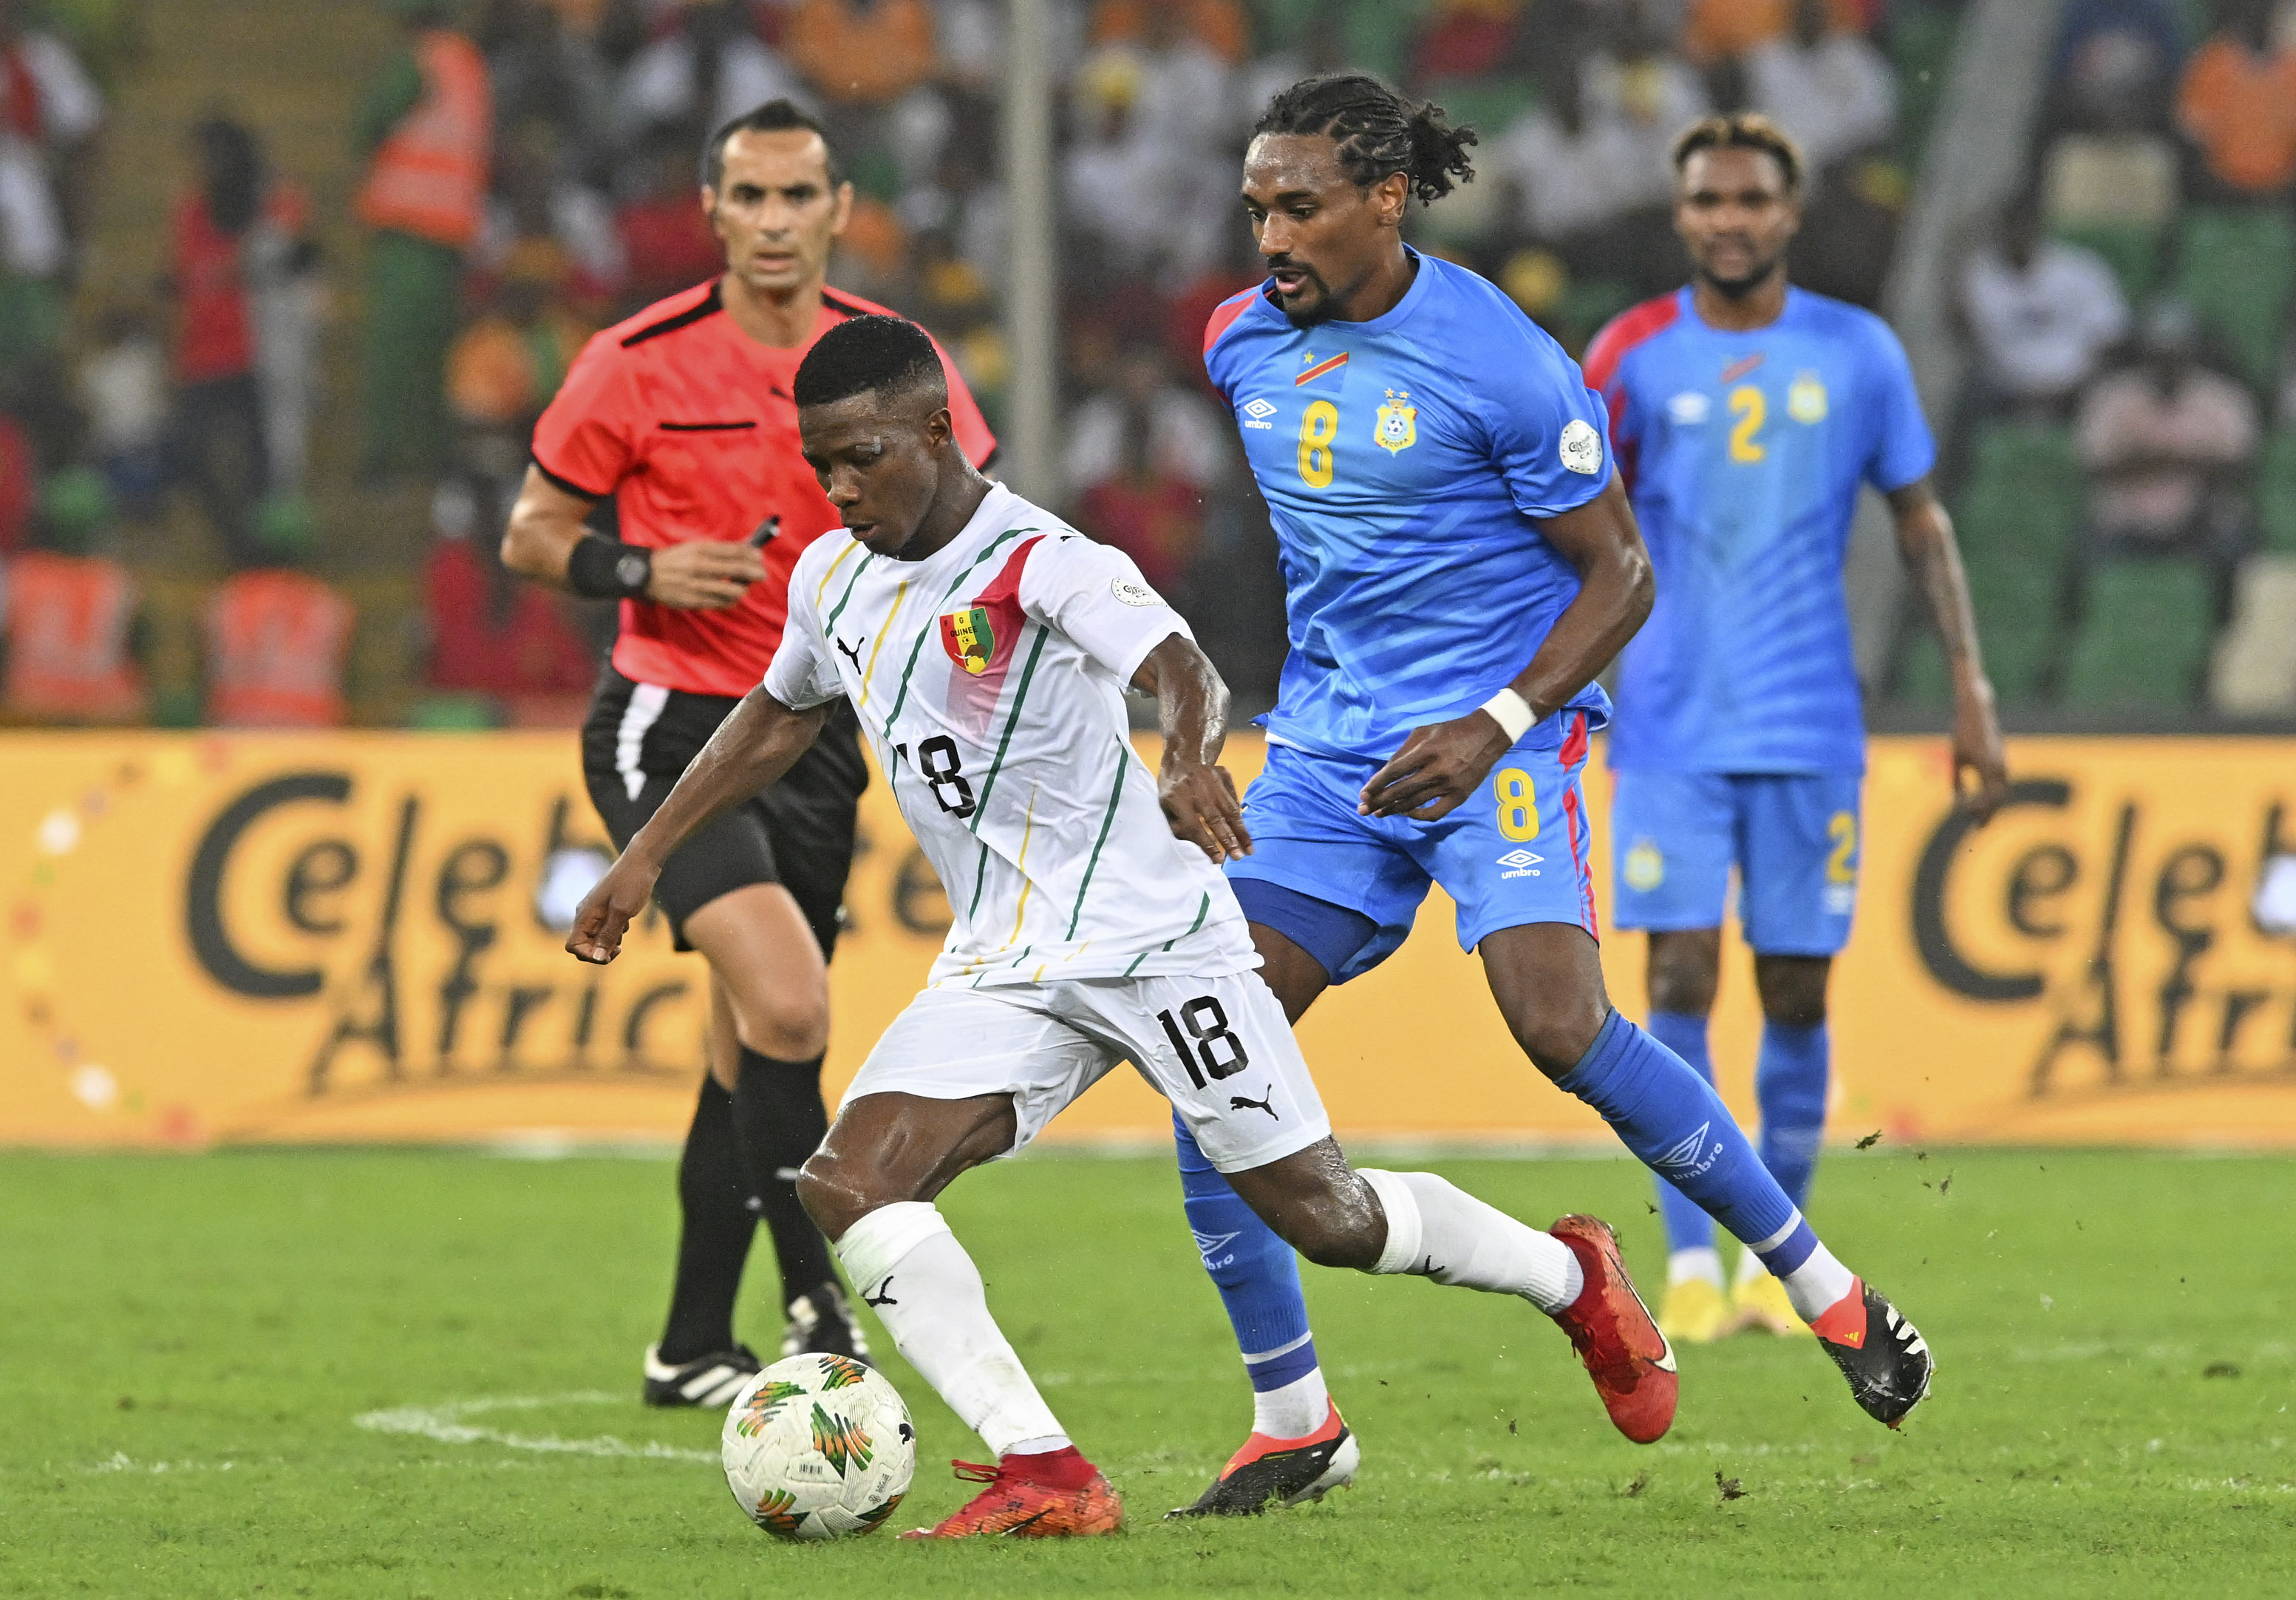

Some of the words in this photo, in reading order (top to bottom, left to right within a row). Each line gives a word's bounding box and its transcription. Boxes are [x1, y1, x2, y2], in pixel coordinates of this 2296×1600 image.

[1244, 419, 1272, 430] umbro
[1298, 400, 1338, 488] 8
[1730, 385, 1765, 463] 2
[950, 625, 978, 638] GUINEE
[896, 735, 977, 820] 8
[1493, 767, 1540, 842] 8
[1501, 868, 1541, 879] umbro
[1825, 810, 1856, 883] 2
[1156, 995, 1249, 1090] 18
[1672, 1143, 1723, 1179] umbro
[1204, 1254, 1234, 1270] bro
